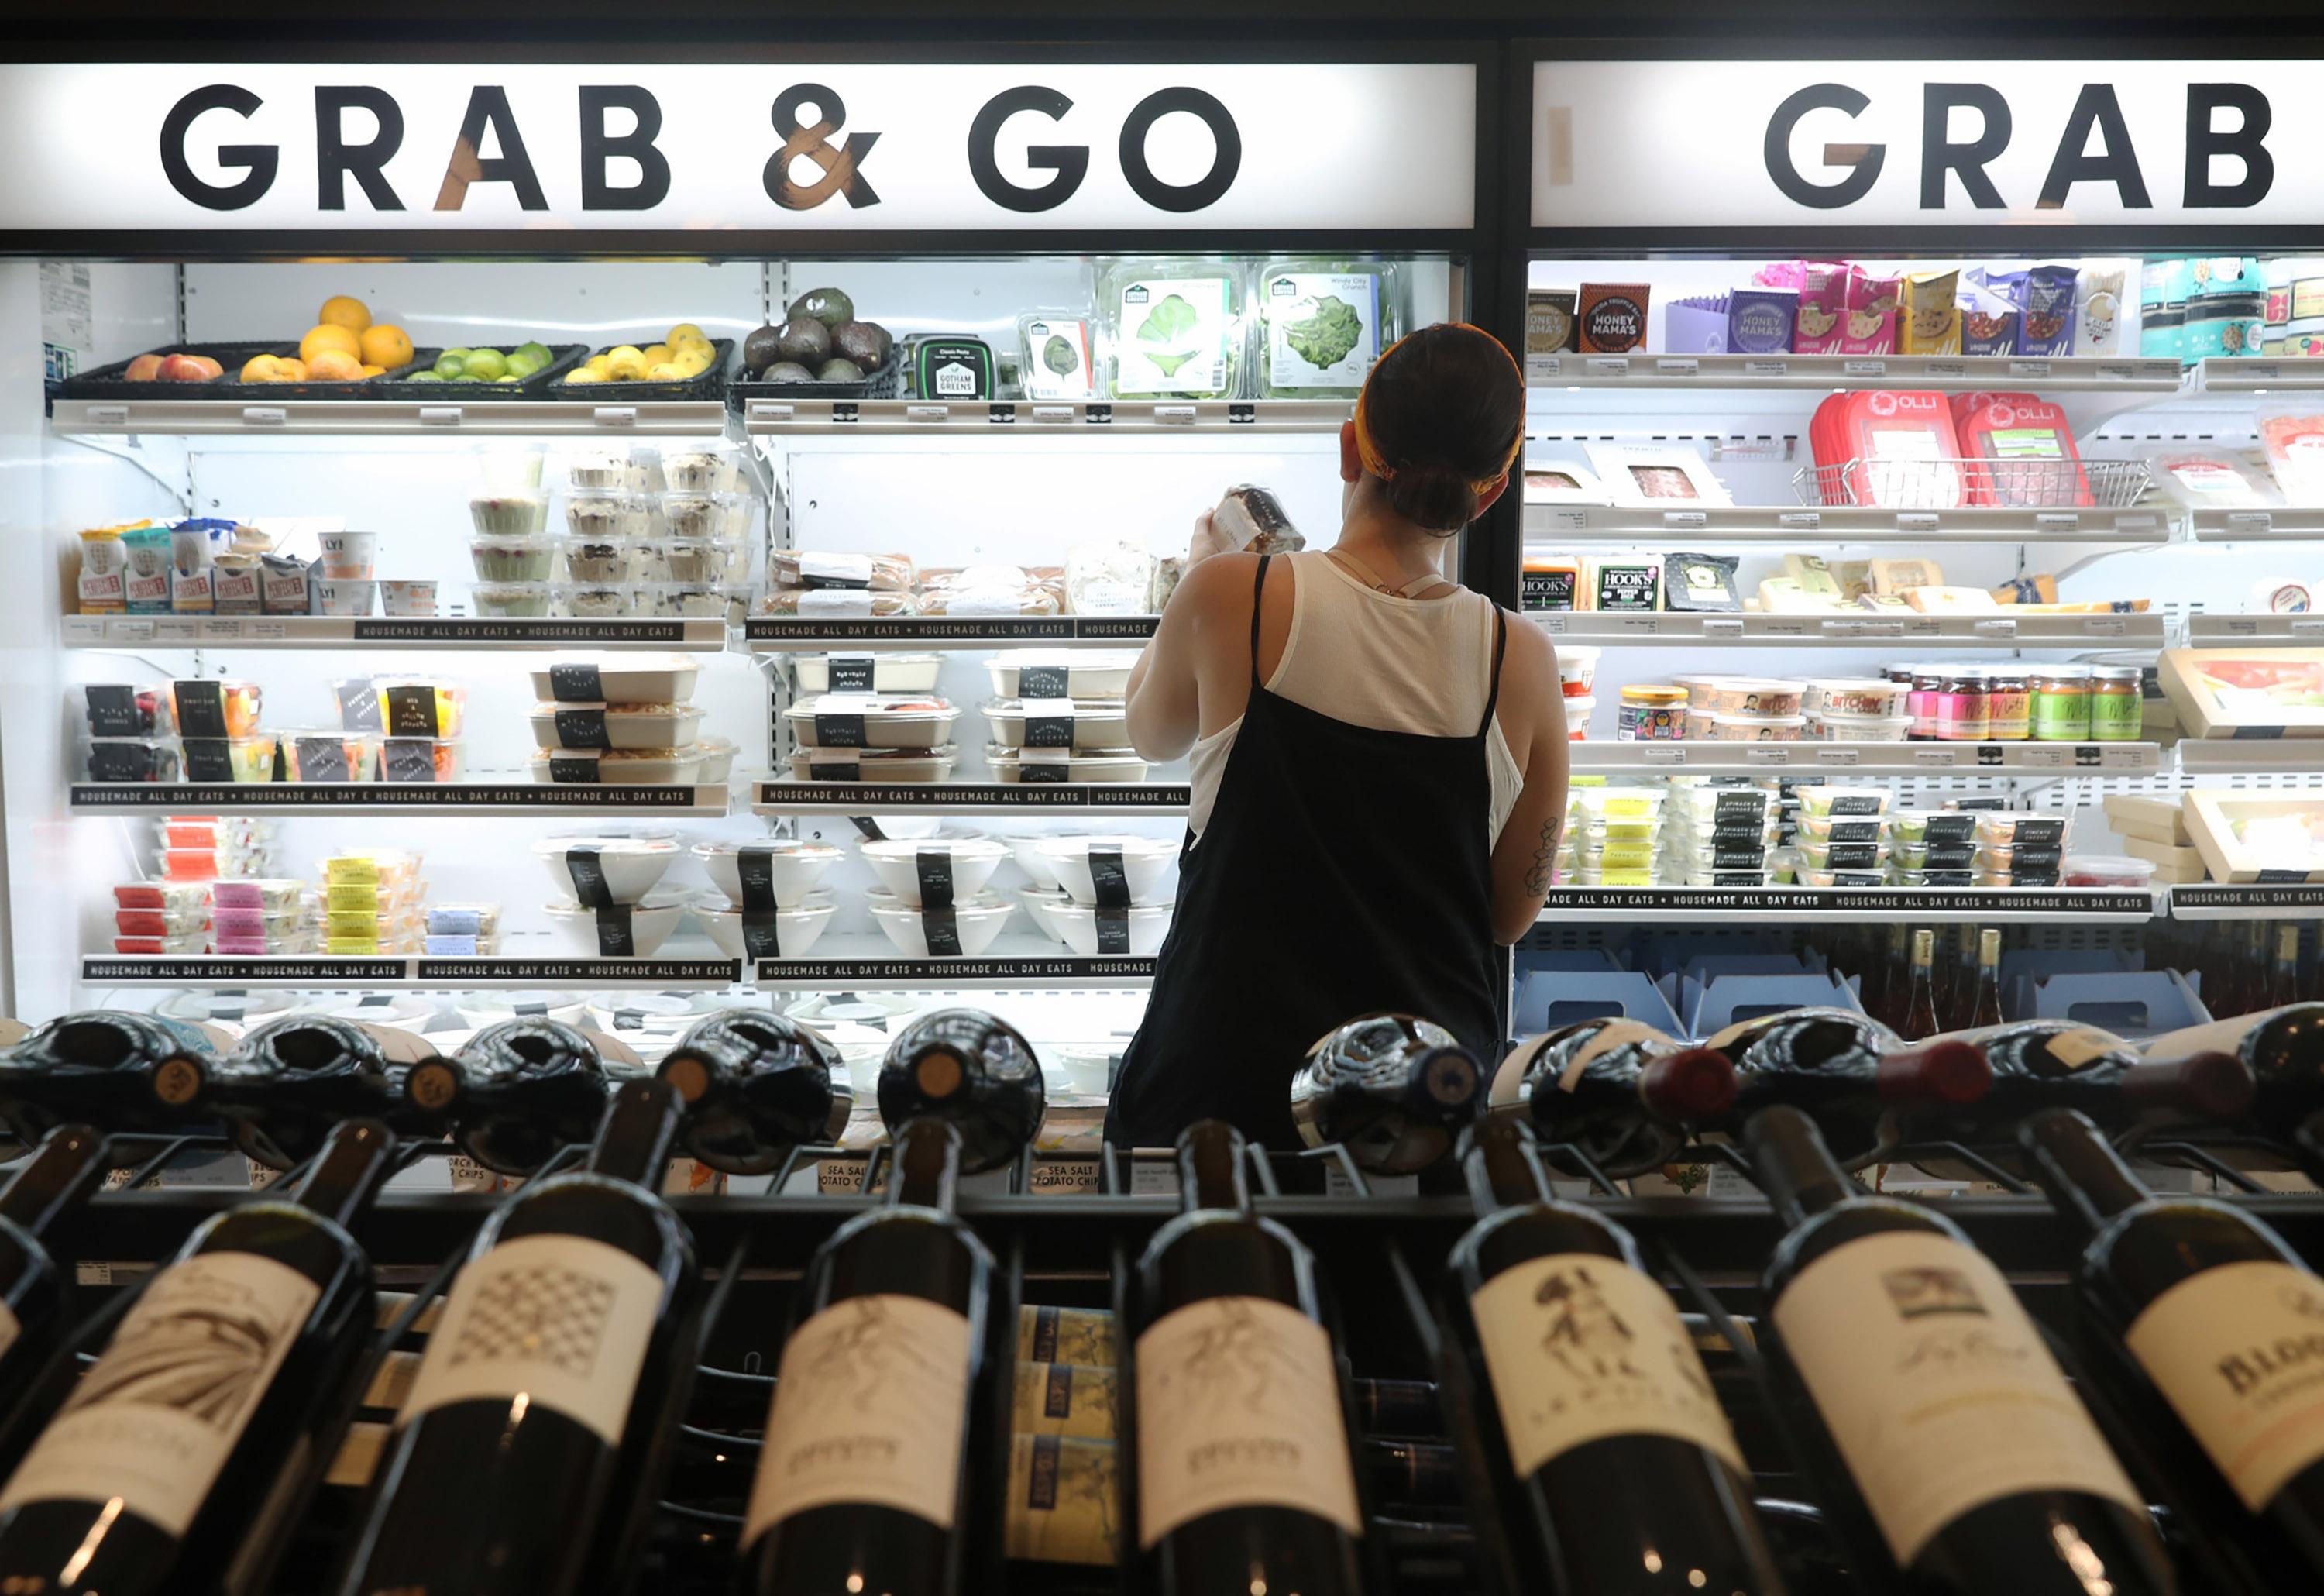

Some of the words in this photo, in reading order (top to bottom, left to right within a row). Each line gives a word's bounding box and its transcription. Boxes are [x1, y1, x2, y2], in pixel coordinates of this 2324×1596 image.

[160, 84, 671, 212] GRAB
[763, 83, 882, 211] &
[968, 85, 1241, 213] GO
[1764, 82, 2274, 210] GRAB
[1530, 315, 1560, 325] ONEY
[1596, 315, 1634, 325] HONEY
[1742, 316, 1780, 325] HONEY
[1528, 325, 1562, 334] AMA'S
[1593, 325, 1636, 334] MAMA'S
[1740, 325, 1782, 335] MAMA'S
[1899, 395, 1937, 409] OLLI
[2016, 408, 2055, 420] OLLI
[1604, 573, 1653, 585] HOOK'S
[363, 626, 425, 636] HOUSEMADE
[432, 627, 450, 636] ALL
[457, 627, 476, 636] DAY
[483, 627, 509, 636] EATS
[528, 627, 590, 637] HOUSEMADE
[597, 627, 616, 636] ALL
[622, 627, 641, 636] DAY
[648, 627, 674, 636] EATS
[754, 626, 816, 635] HOUSEMADE
[823, 626, 841, 635] ALL
[847, 626, 867, 635] DAY
[874, 625, 899, 635] EATS
[919, 625, 982, 635] HOUSEMADE
[988, 625, 1006, 635] ALL
[1012, 624, 1034, 635] DAY
[1039, 624, 1064, 635] EATS
[1085, 624, 1147, 634] HOUSEMADE
[79, 792, 142, 802] HOUSEMADE
[148, 792, 166, 801] ALL
[173, 792, 192, 801] DAY
[198, 792, 225, 801] EATS
[243, 791, 304, 801] HOUSEMADE
[312, 792, 329, 800] ALL
[337, 791, 356, 800] DAY
[376, 791, 438, 801] HOUSEMADE
[445, 792, 462, 801] ALL
[469, 791, 489, 801] DAY
[495, 791, 521, 801] EATS
[540, 791, 602, 801] HOUSEMADE
[608, 792, 626, 801] ALL
[633, 792, 652, 801] DAY
[658, 792, 684, 801] EATS
[770, 790, 831, 800] HOUSEMADE
[838, 791, 856, 800] ALL
[863, 791, 882, 800] DAY
[889, 791, 915, 800] EATS
[933, 792, 995, 801] HOUSEMADE
[1002, 792, 1020, 801] ALL
[1027, 792, 1047, 801] DAY
[1053, 792, 1078, 802] EATS
[1098, 792, 1159, 802] HOUSEMADE
[1166, 793, 1184, 802] ALL
[1578, 895, 1596, 904] ALL
[1603, 895, 1622, 904] DAY
[1628, 895, 1654, 904] EATS
[1673, 895, 1736, 905] HOUSEMADE
[1742, 896, 1760, 905] ALL
[1767, 896, 1787, 905] DAY
[1793, 896, 1819, 905] EATS
[1836, 896, 1898, 906] HOUSEMADE
[1904, 897, 1923, 906] ALL
[1929, 897, 1948, 906] DAY
[1954, 897, 1980, 906] EATS
[1999, 897, 2060, 907] HOUSEMADE
[2067, 898, 2085, 907] ALL
[2091, 898, 2110, 907] DAY
[2116, 898, 2142, 908] EATS
[2180, 893, 2242, 903] HOUSEMADE
[2248, 893, 2266, 903] ALL
[2273, 893, 2292, 902] DAY
[2298, 892, 2324, 902] EATS
[90, 965, 153, 976] HOUSEMADE
[158, 966, 177, 975] ALL
[183, 965, 202, 975] DAY
[208, 966, 234, 975] EATS
[253, 966, 315, 975] HOUSEMADE
[320, 966, 339, 975] ALL
[345, 966, 364, 975] DAY
[370, 966, 397, 975] EATS
[426, 965, 487, 975] HOUSEMADE
[493, 966, 512, 975] ALL
[518, 965, 538, 975] DAY
[544, 965, 569, 975] EATS
[589, 966, 650, 975] HOUSEMADE
[656, 966, 675, 975] ALL
[681, 965, 700, 975] DAY
[706, 966, 732, 975] EATS
[766, 965, 827, 975] HOUSEMADE
[834, 966, 852, 975] ALL
[859, 965, 878, 975] DAY
[885, 965, 909, 975] EATS
[929, 964, 990, 974] HOUSEMADE
[996, 965, 1015, 974] ALL
[1021, 964, 1040, 973] DAY
[1047, 963, 1072, 973] EATS
[1090, 963, 1152, 972] HOUSEMADE
[827, 1165, 844, 1175] SEA
[1048, 1166, 1067, 1175] SEA
[1071, 1166, 1093, 1175] SALT
